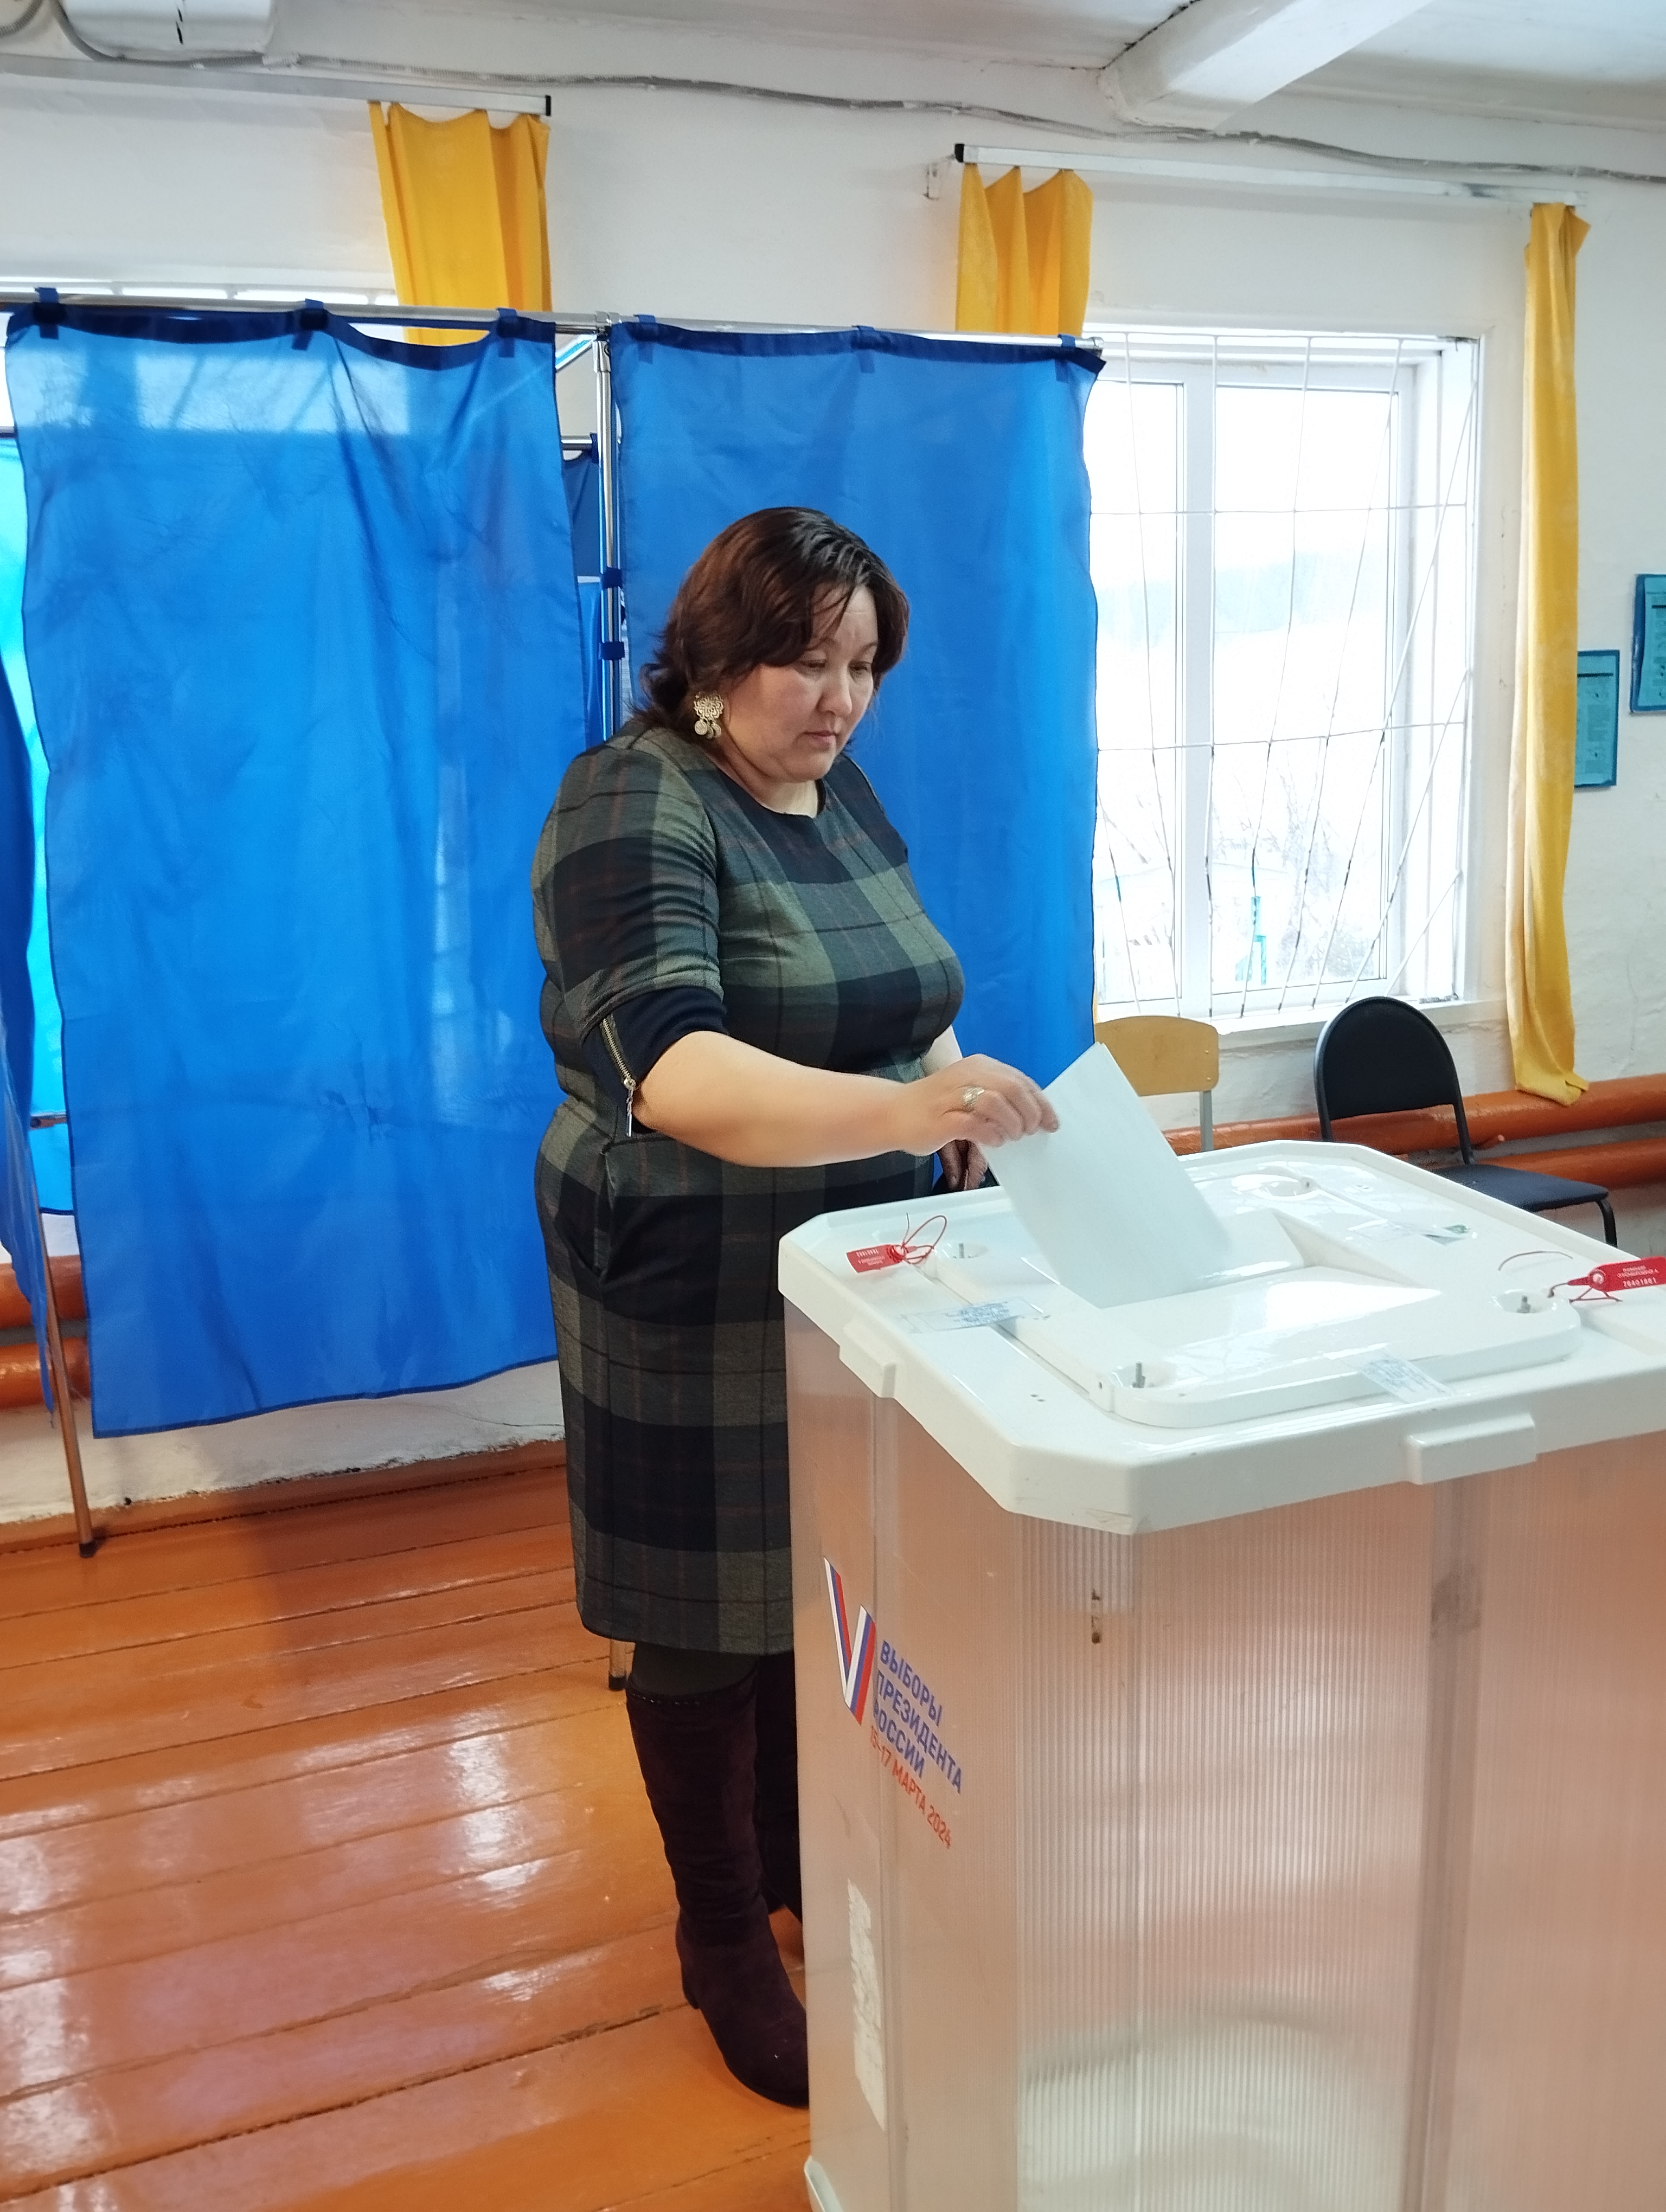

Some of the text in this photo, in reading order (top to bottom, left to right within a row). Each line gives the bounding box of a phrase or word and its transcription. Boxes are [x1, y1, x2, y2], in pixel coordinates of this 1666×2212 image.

[880, 1640, 943, 1727] ВЫБОРЫ
[877, 1669, 962, 1795] ПРЕЗИДЕНТА
[892, 1759, 926, 1815] МАРТА
[927, 1804, 951, 1850] 2024
